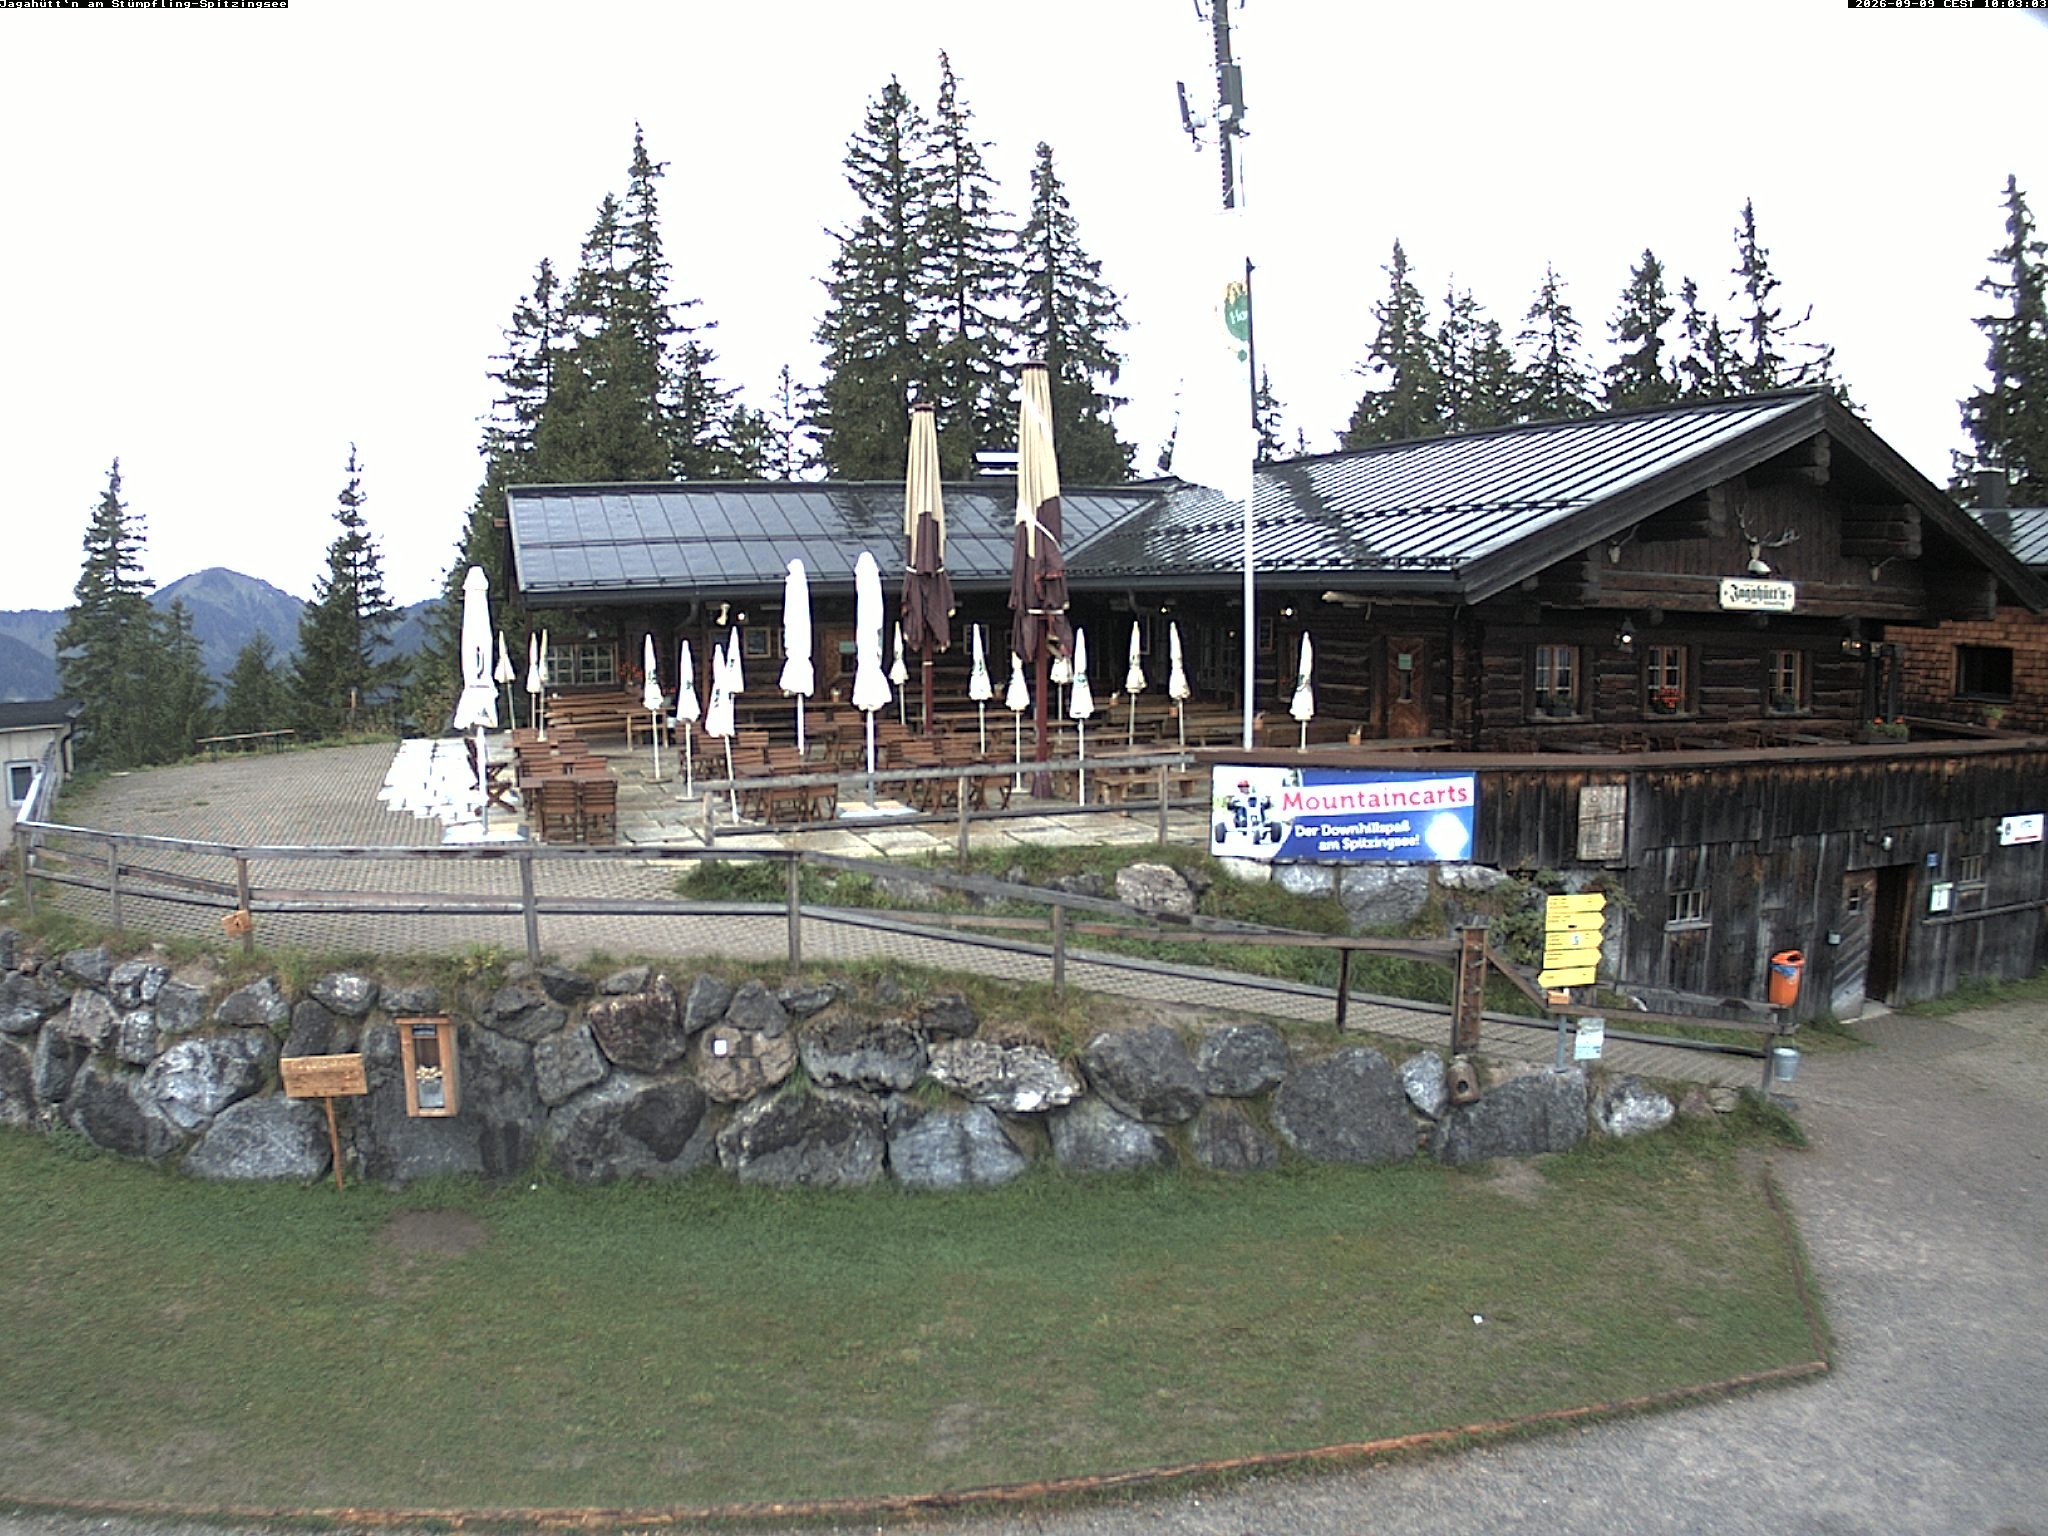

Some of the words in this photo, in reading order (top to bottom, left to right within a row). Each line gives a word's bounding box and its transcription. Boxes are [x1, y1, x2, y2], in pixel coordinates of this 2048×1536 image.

[1282, 785, 1469, 812] Mountaincarts
[1293, 824, 1319, 837] Der
[1318, 841, 1341, 852] am
[1342, 835, 1420, 852] Spitzingsee!
